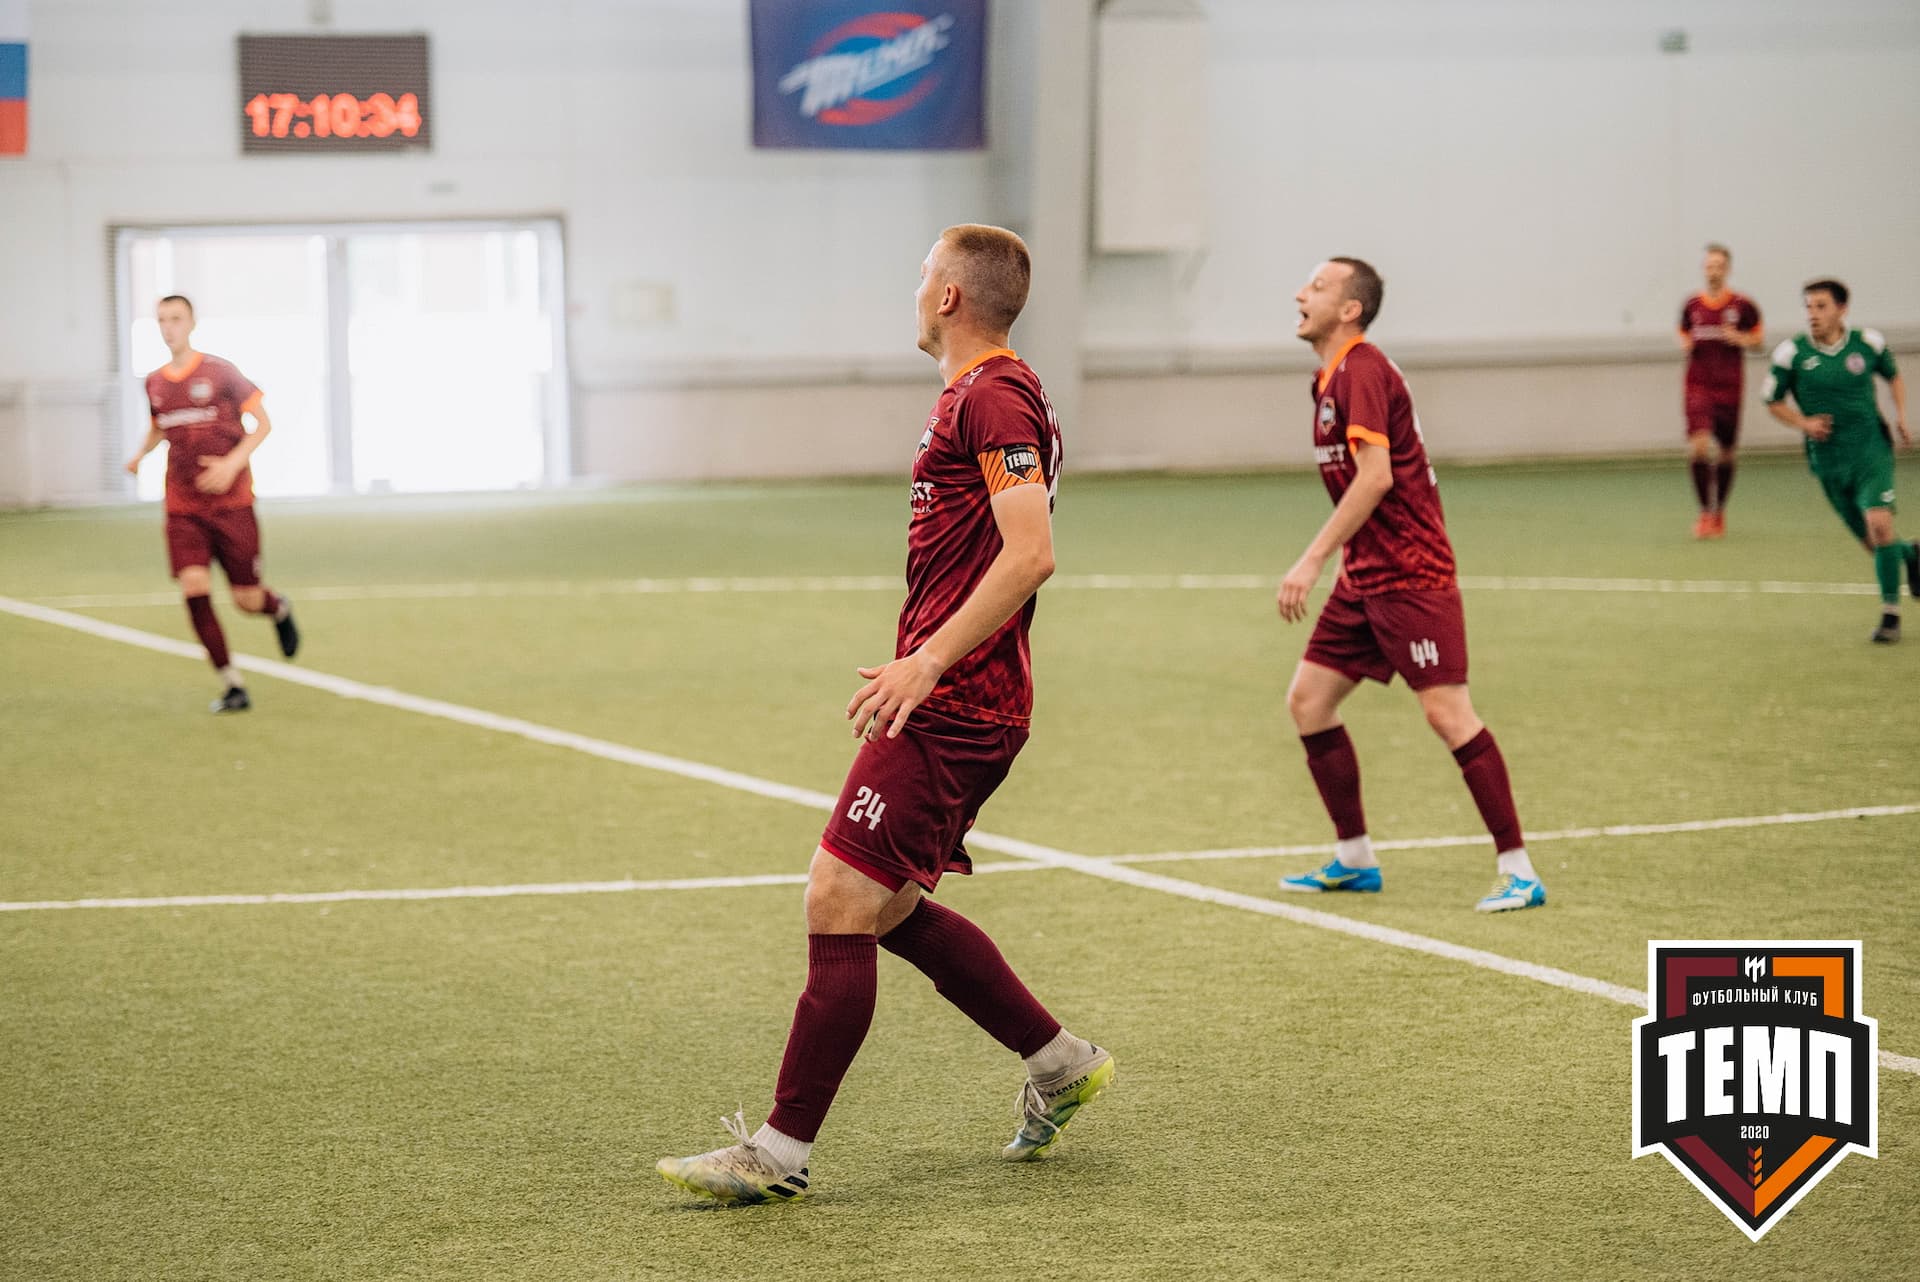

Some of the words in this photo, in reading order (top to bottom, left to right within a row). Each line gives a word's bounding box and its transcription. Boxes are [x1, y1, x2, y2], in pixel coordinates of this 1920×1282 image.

[244, 92, 422, 138] 17:10:34
[1006, 452, 1035, 469] ТЕМП
[1410, 638, 1439, 668] 44
[847, 786, 887, 830] 24
